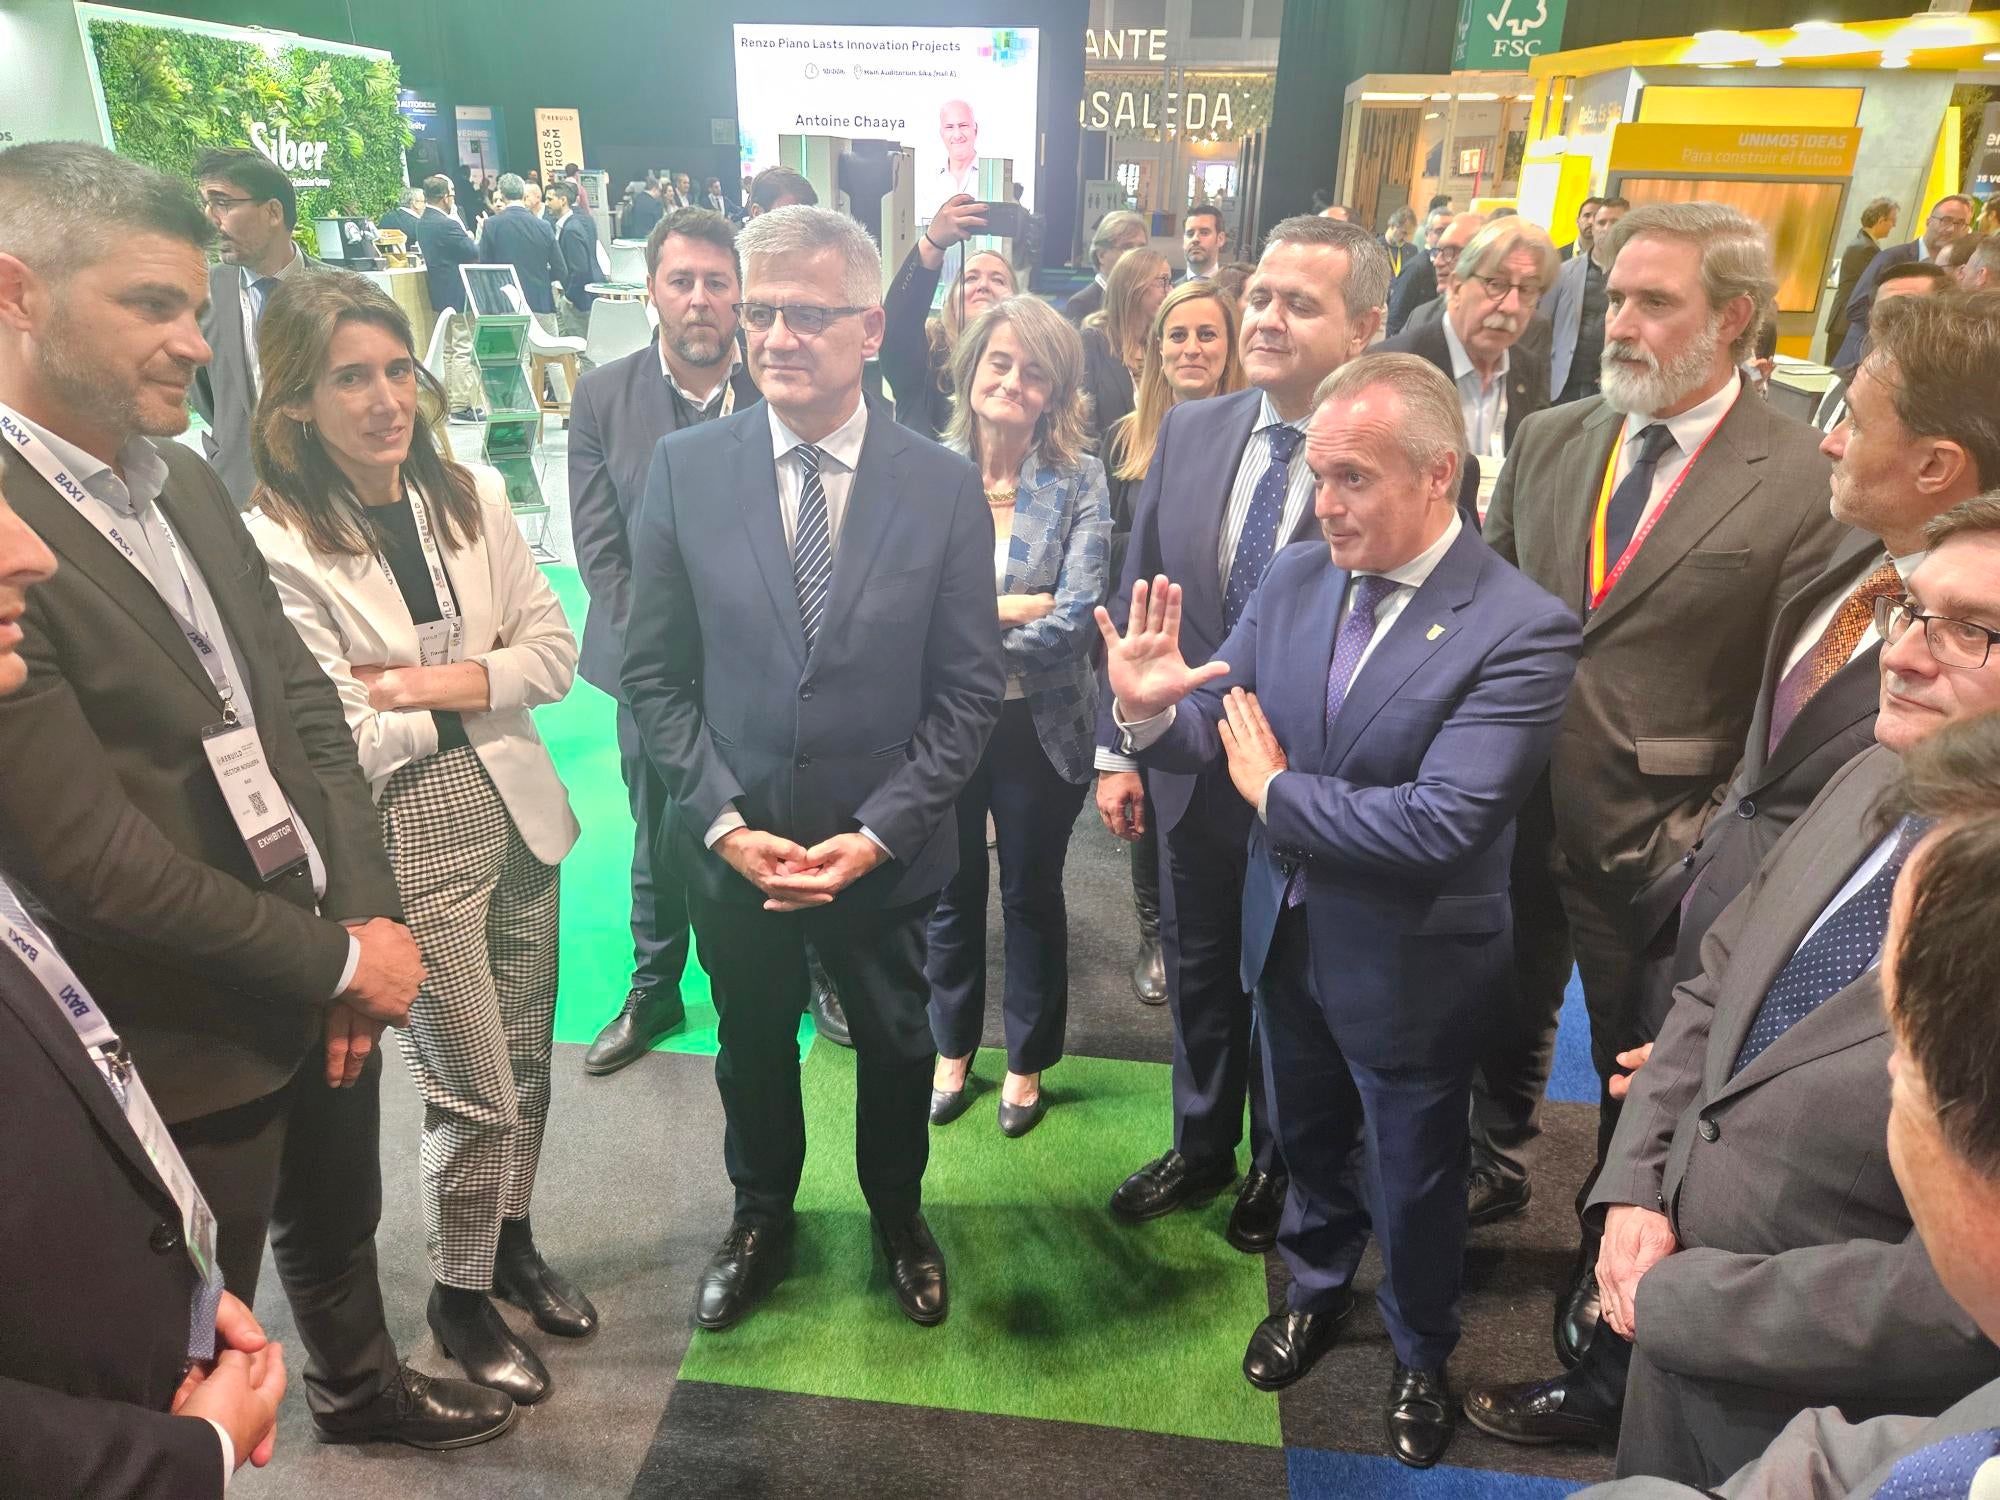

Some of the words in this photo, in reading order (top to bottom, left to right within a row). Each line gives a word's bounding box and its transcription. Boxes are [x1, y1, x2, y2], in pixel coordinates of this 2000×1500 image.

[741, 37, 776, 48] Renzo
[778, 38, 810, 49] Piano
[813, 39, 844, 49] Lasts
[847, 40, 909, 51] Innovation
[912, 41, 961, 52] Projects
[1492, 40, 1542, 57] FSC
[795, 113, 850, 127] Antoine
[853, 115, 906, 131] Chaaya
[250, 122, 328, 171] Siber
[551, 128, 563, 166] ROOM
[1738, 132, 1799, 149] UNIMOS
[1802, 133, 1848, 149] IDEAS
[1682, 147, 1713, 163] Para
[1715, 150, 1777, 164] construir
[1781, 150, 1793, 165] el
[1797, 150, 1842, 167] futuro
[0, 416, 31, 447] BAXI
[54, 472, 85, 503] BAXI
[109, 528, 133, 556] BAXI
[187, 631, 212, 656] BAXI
[257, 825, 292, 849] EXHIBITOR
[9, 927, 39, 962] BAXI
[60, 984, 90, 1018] BAXI
